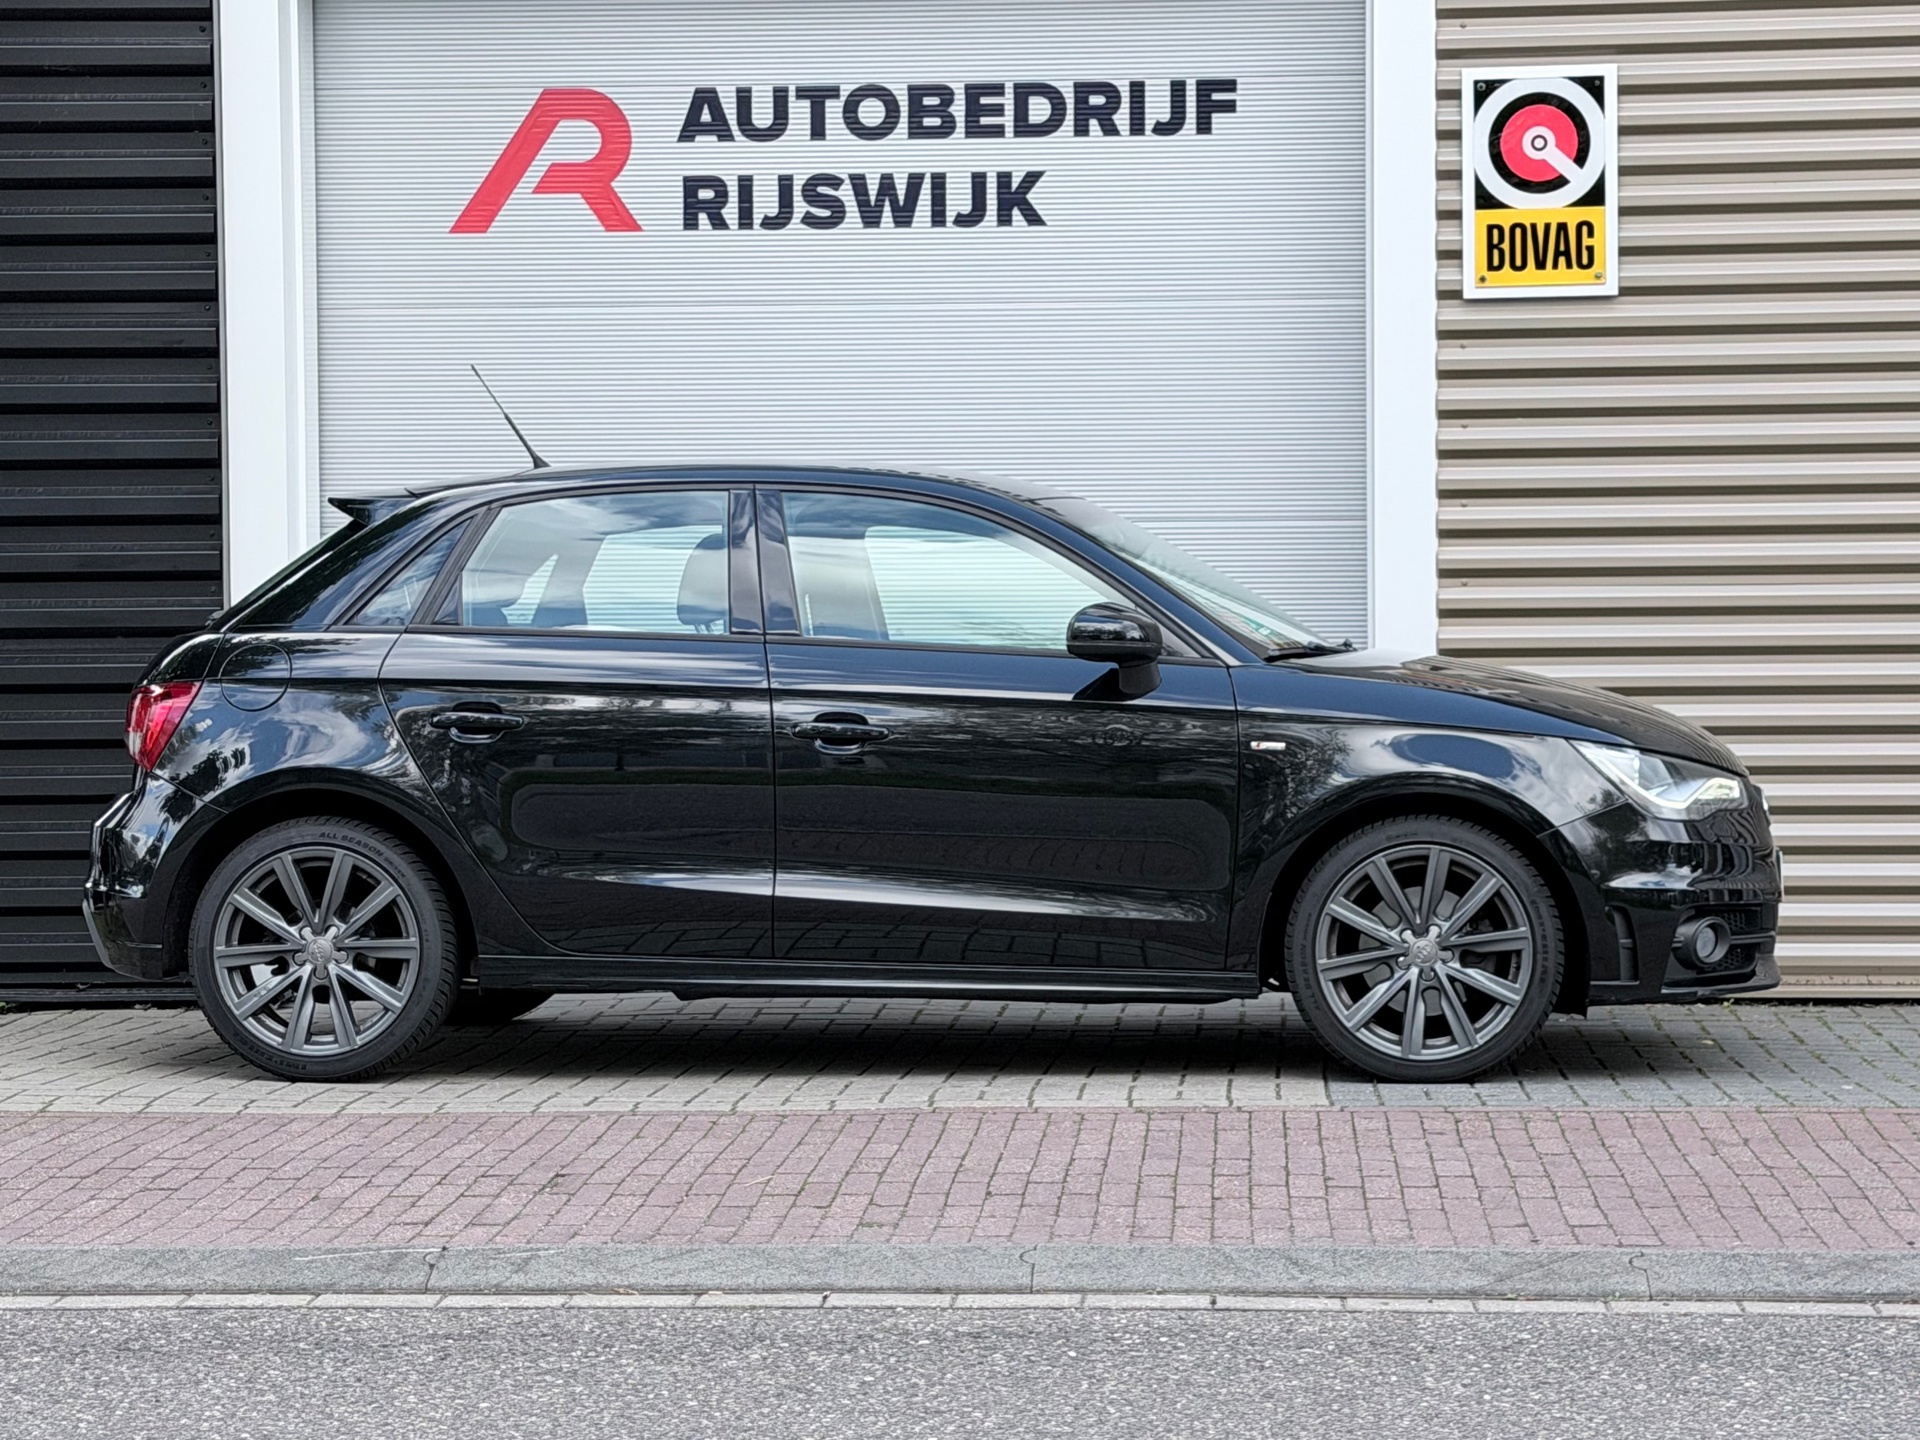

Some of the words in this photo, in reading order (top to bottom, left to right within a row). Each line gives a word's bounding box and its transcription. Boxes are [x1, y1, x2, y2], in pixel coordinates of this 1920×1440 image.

[677, 79, 1238, 143] AUTOBEDRIJF
[682, 170, 1047, 231] RIJSWIJK
[1486, 220, 1596, 273] BOVAG
[319, 831, 339, 840] ALL
[341, 834, 384, 857] SEASON
